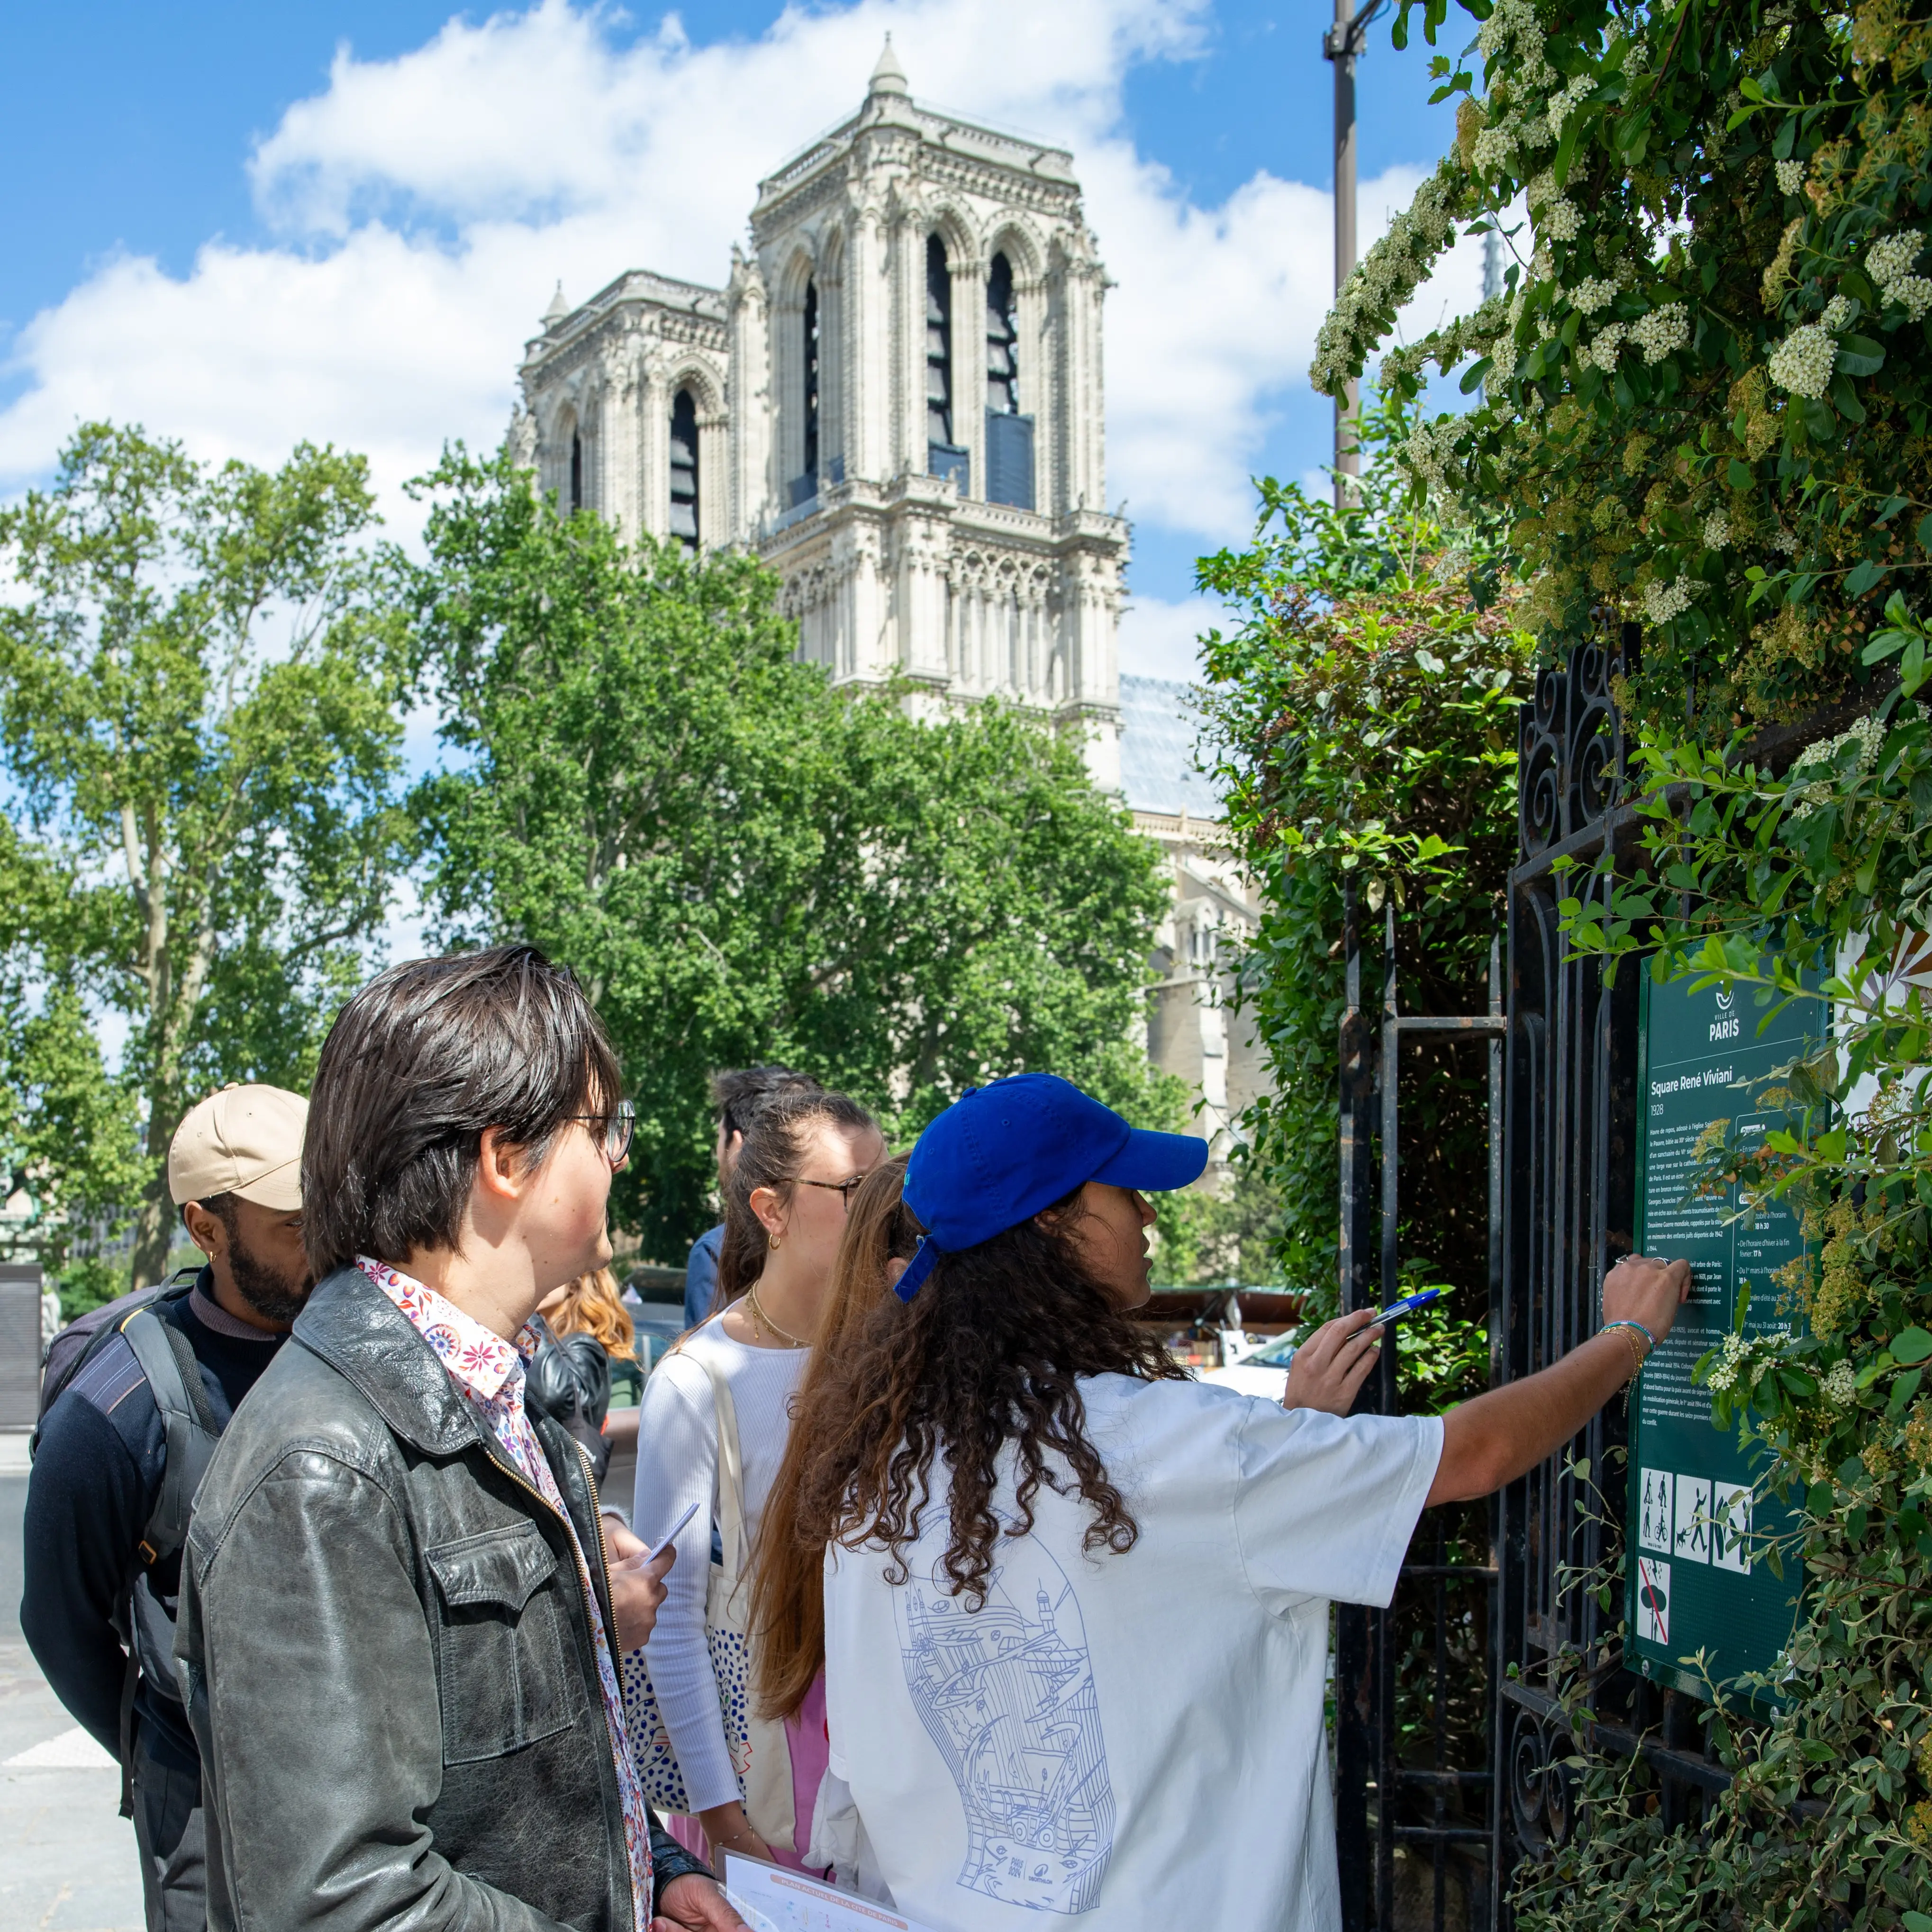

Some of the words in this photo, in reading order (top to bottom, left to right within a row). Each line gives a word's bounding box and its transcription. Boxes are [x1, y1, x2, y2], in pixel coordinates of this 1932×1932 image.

[1714, 1012, 1727, 1020] VILLE
[1709, 1018, 1739, 1042] PARIS
[1651, 1080, 1678, 1098] Square
[1680, 1072, 1701, 1090] René
[1703, 1065, 1732, 1086] Viviani
[1651, 1104, 1664, 1116] 1928
[1690, 1219, 1705, 1227] rappelés
[1694, 1231, 1709, 1240] déportés
[1011, 1857, 1024, 1869] PARIS
[1008, 1866, 1021, 1878] 2024
[1028, 1876, 1053, 1885] DECATHLON
[781, 1879, 800, 1889] PLAN
[802, 1886, 828, 1899] ACTUEL
[878, 1914, 898, 1926] PARIS
